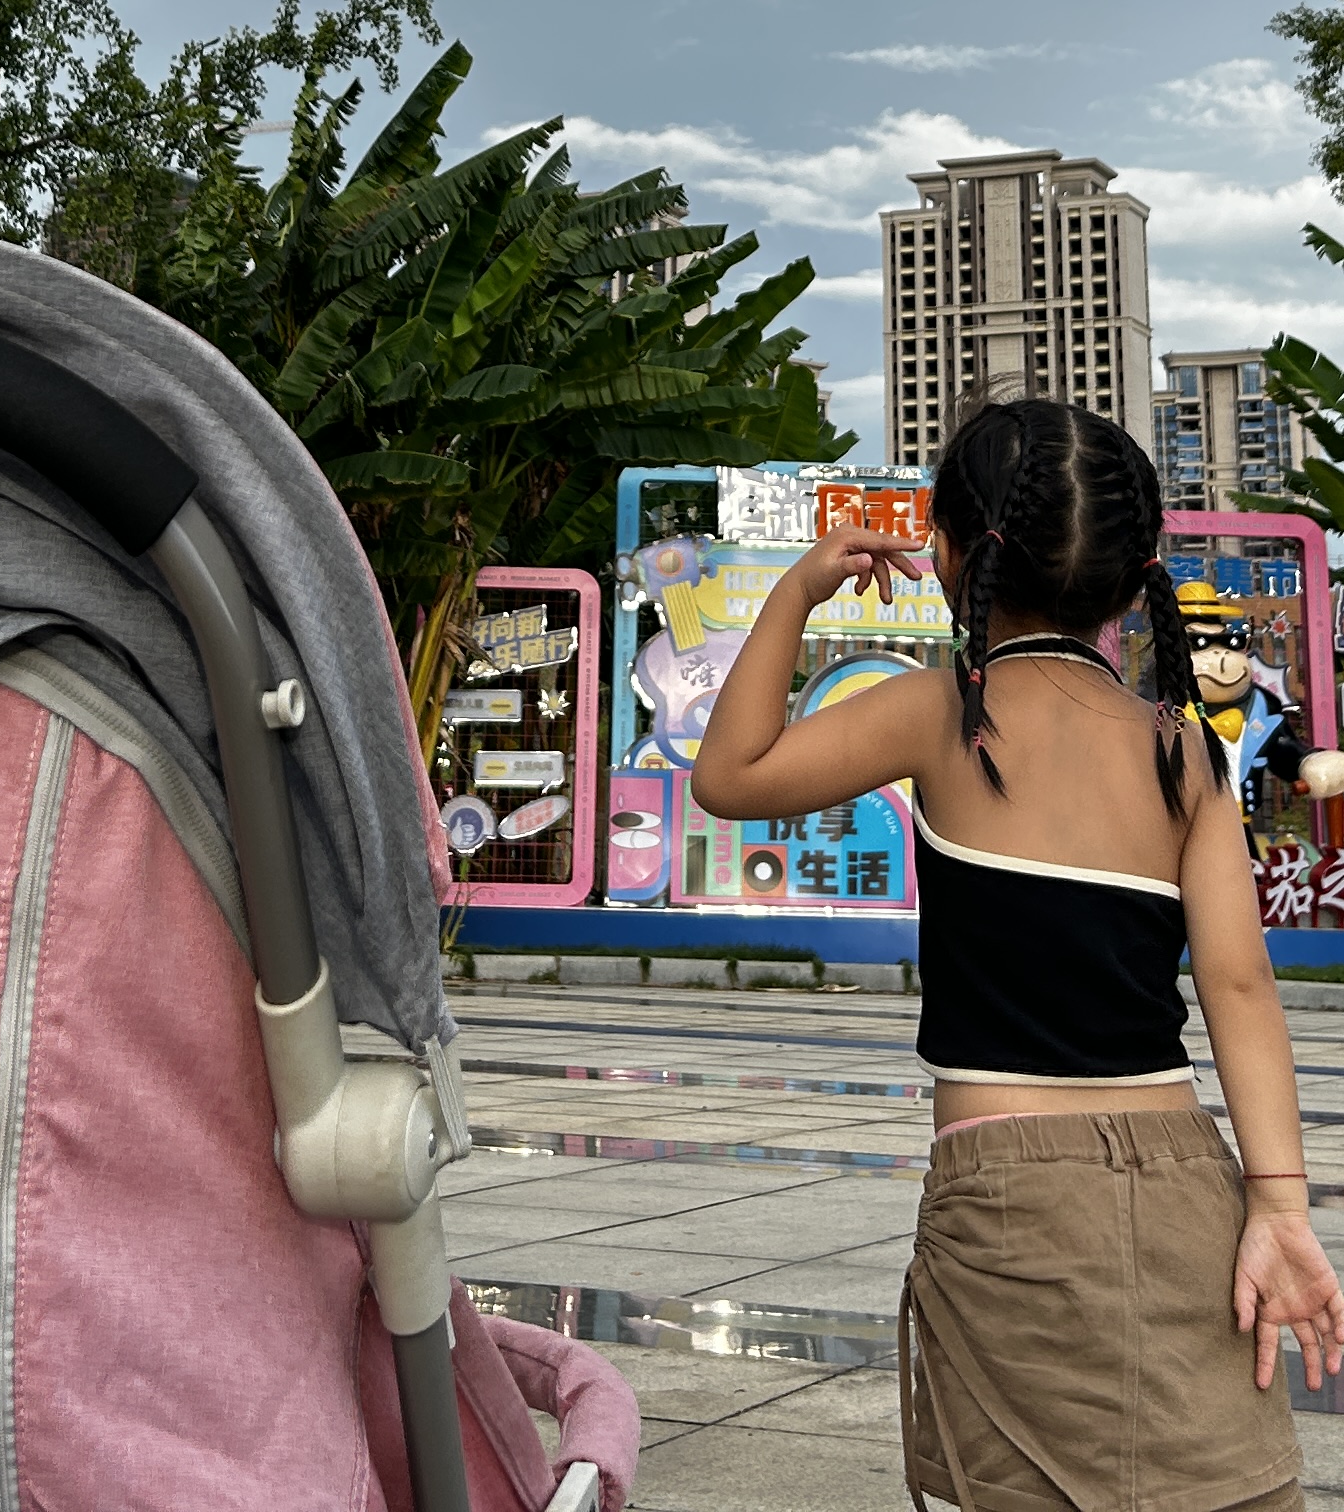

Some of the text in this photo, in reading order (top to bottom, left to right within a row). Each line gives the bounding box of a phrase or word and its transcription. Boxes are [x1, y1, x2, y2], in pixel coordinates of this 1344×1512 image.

[724, 597, 863, 623] WEEND
[487, 632, 572, 670] 乐随行
[795, 849, 890, 896] 生活
